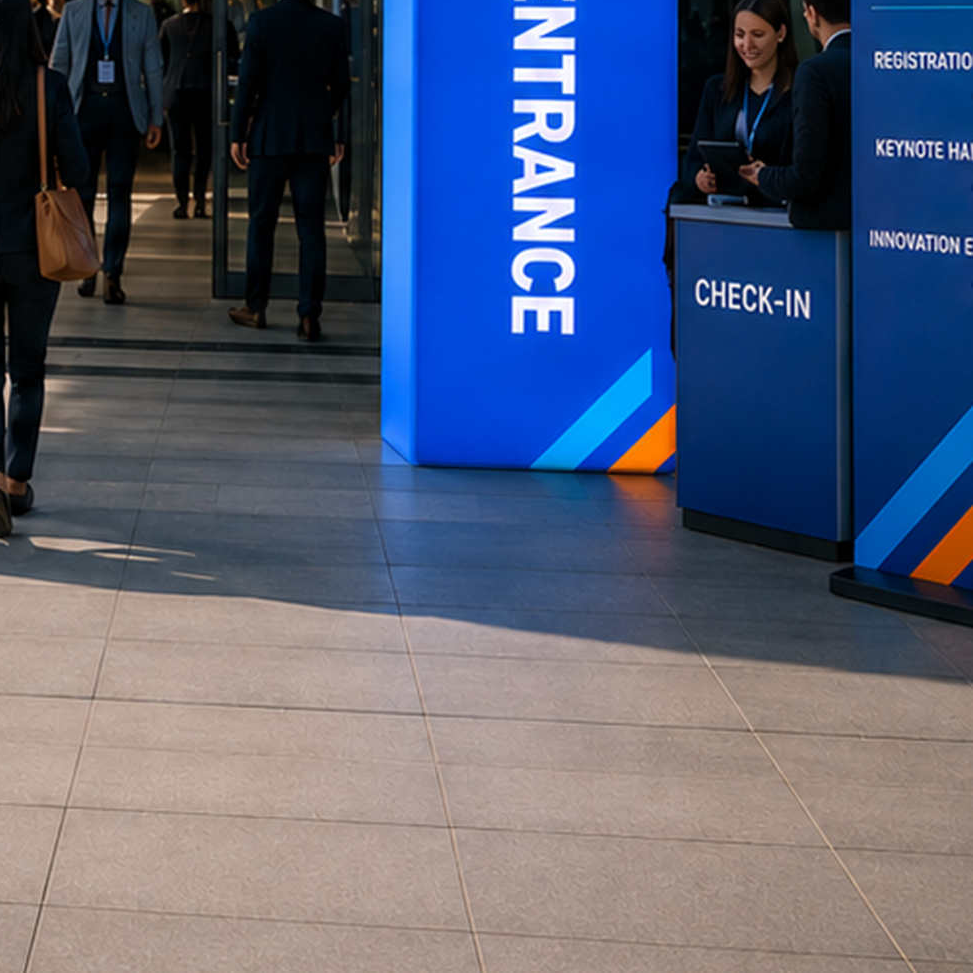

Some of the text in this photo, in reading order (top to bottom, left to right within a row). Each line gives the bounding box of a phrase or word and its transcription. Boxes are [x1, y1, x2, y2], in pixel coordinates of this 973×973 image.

[875, 138, 973, 161] KEYNOTE HA
[869, 229, 962, 256] INNOVATION
[695, 278, 812, 320] CHECK-IN
